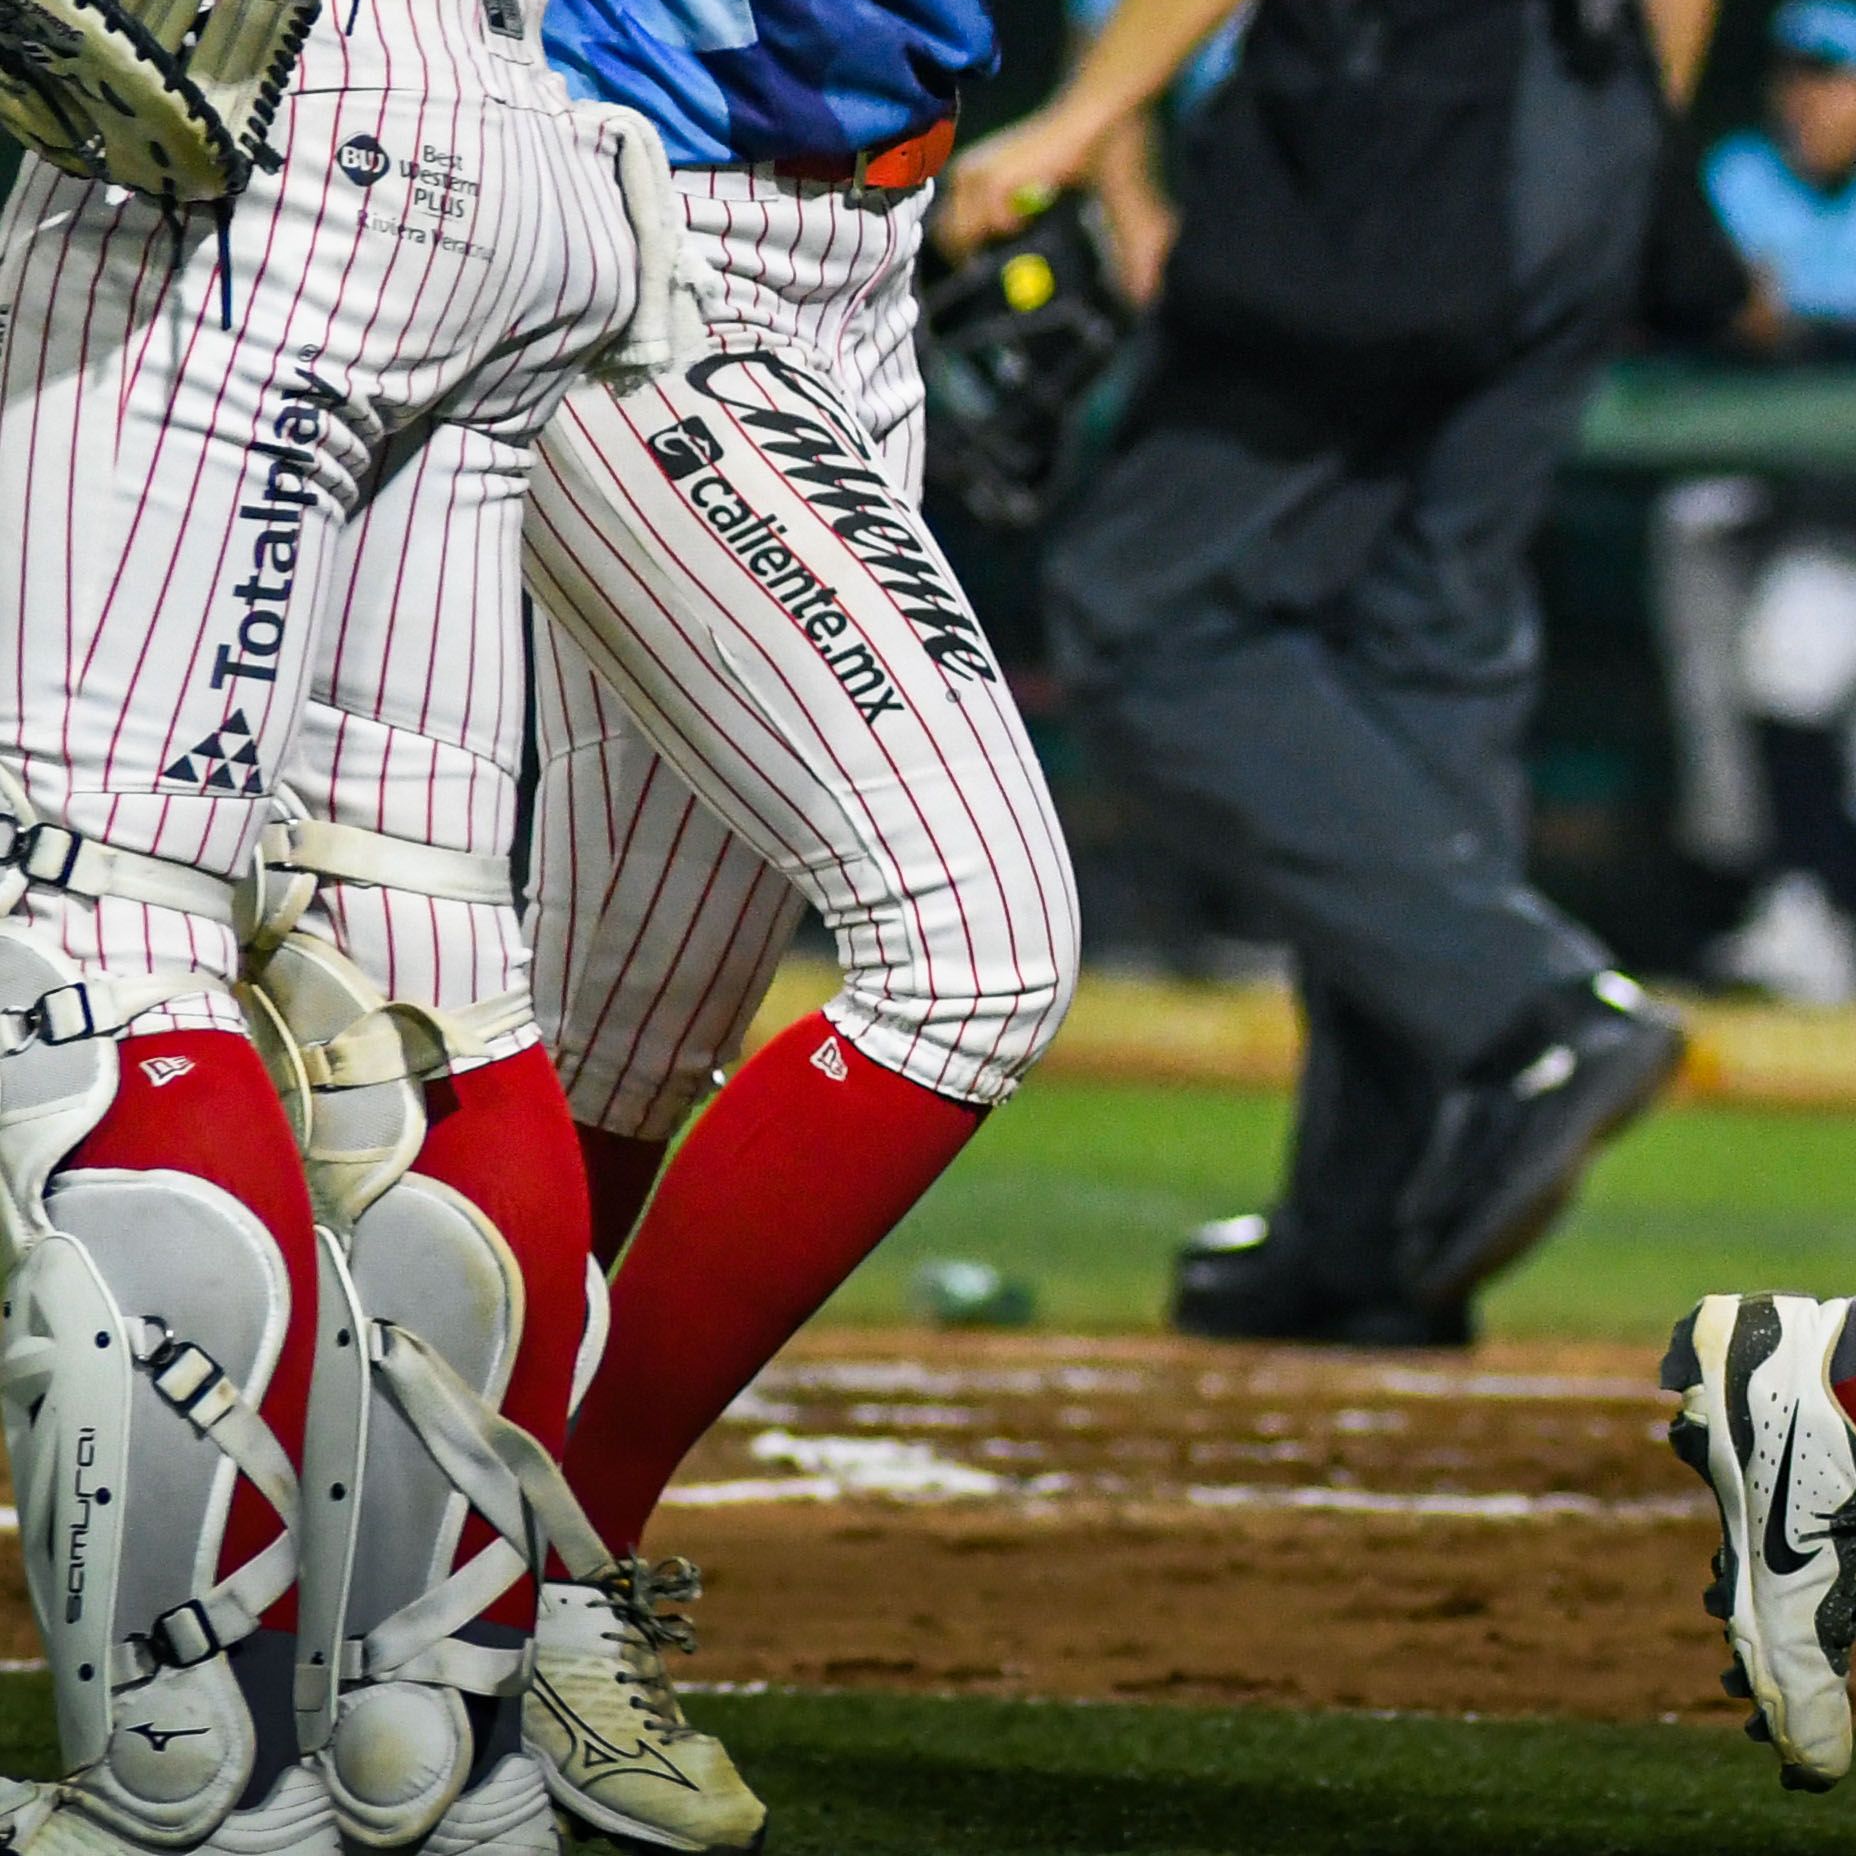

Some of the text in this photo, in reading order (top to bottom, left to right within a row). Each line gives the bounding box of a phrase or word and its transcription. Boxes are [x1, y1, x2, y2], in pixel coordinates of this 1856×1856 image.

[413, 188, 464, 218] PLUS
[210, 366, 348, 690] Totalplay
[690, 475, 908, 728] caliente.mx
